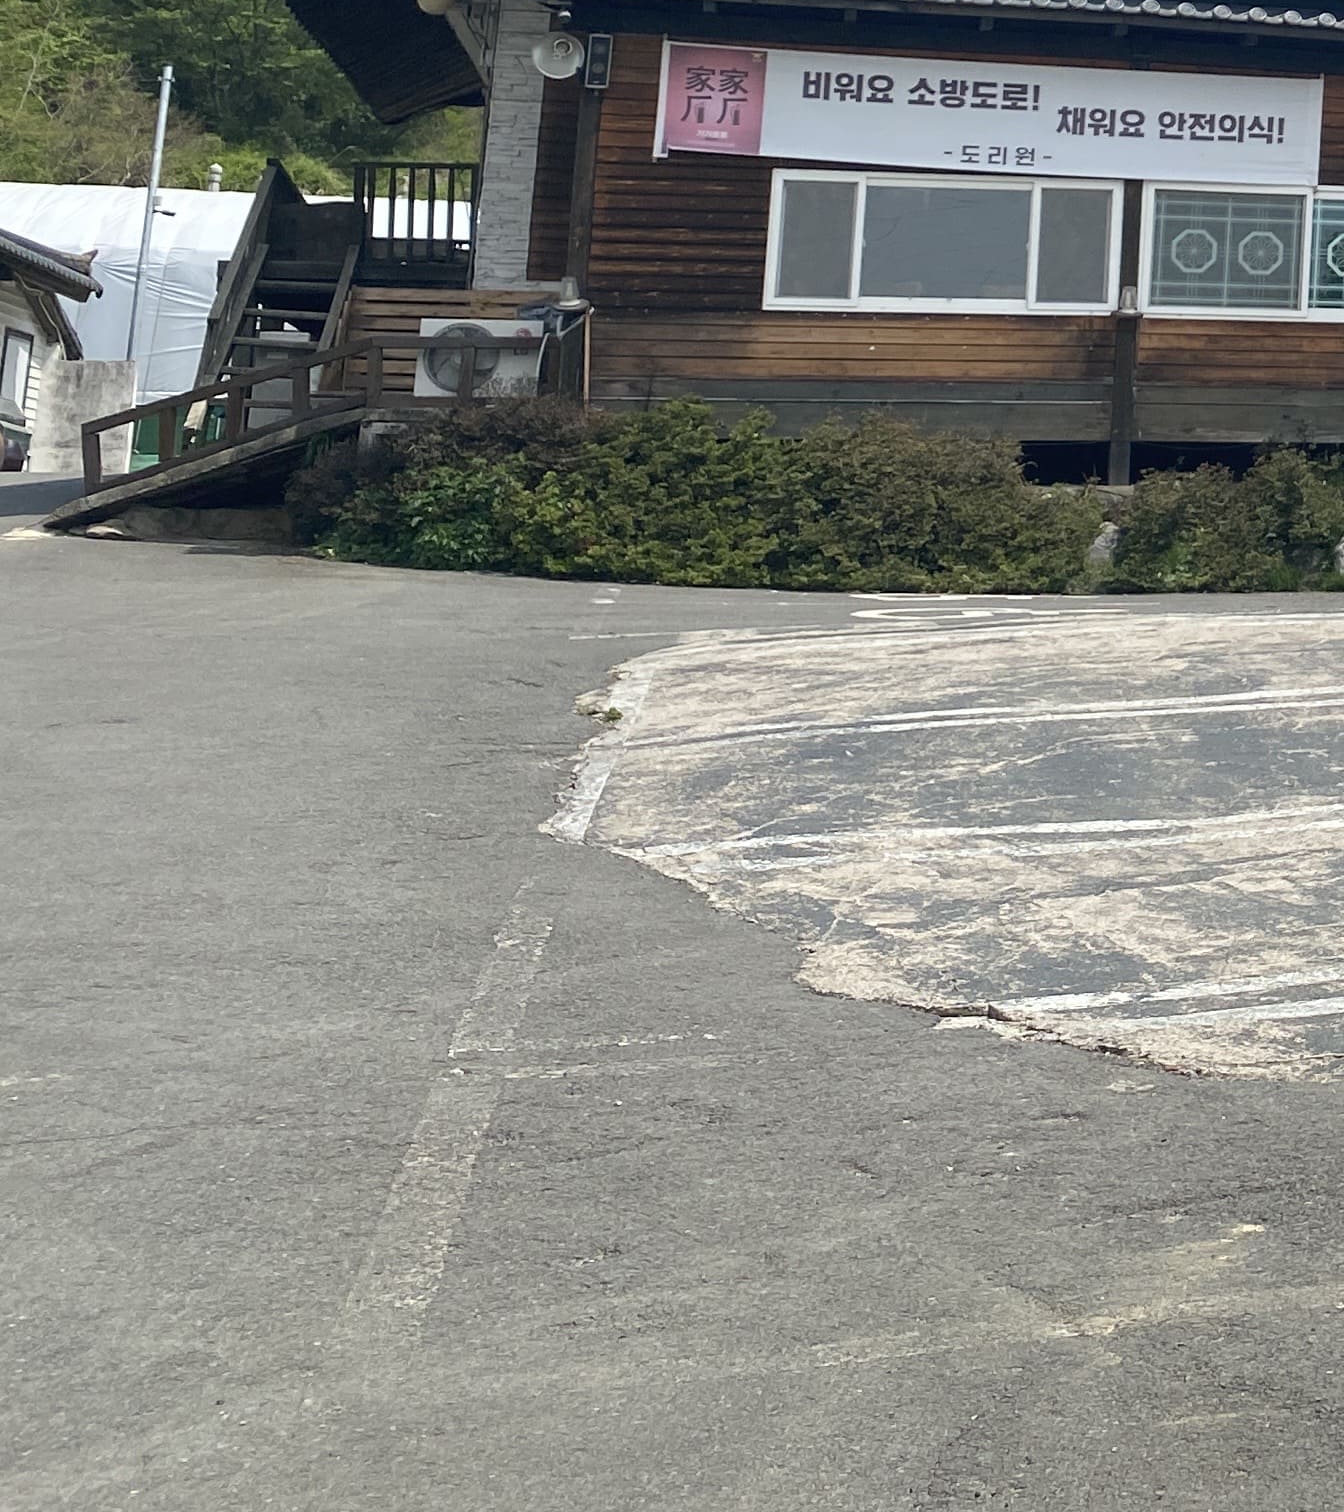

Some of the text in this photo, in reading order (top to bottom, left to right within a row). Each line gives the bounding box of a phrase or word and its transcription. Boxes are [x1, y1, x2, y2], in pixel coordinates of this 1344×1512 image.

[802, 70, 1041, 112] 비워요 소방도로!
[1056, 105, 1285, 145] 채워요 안전의식!
